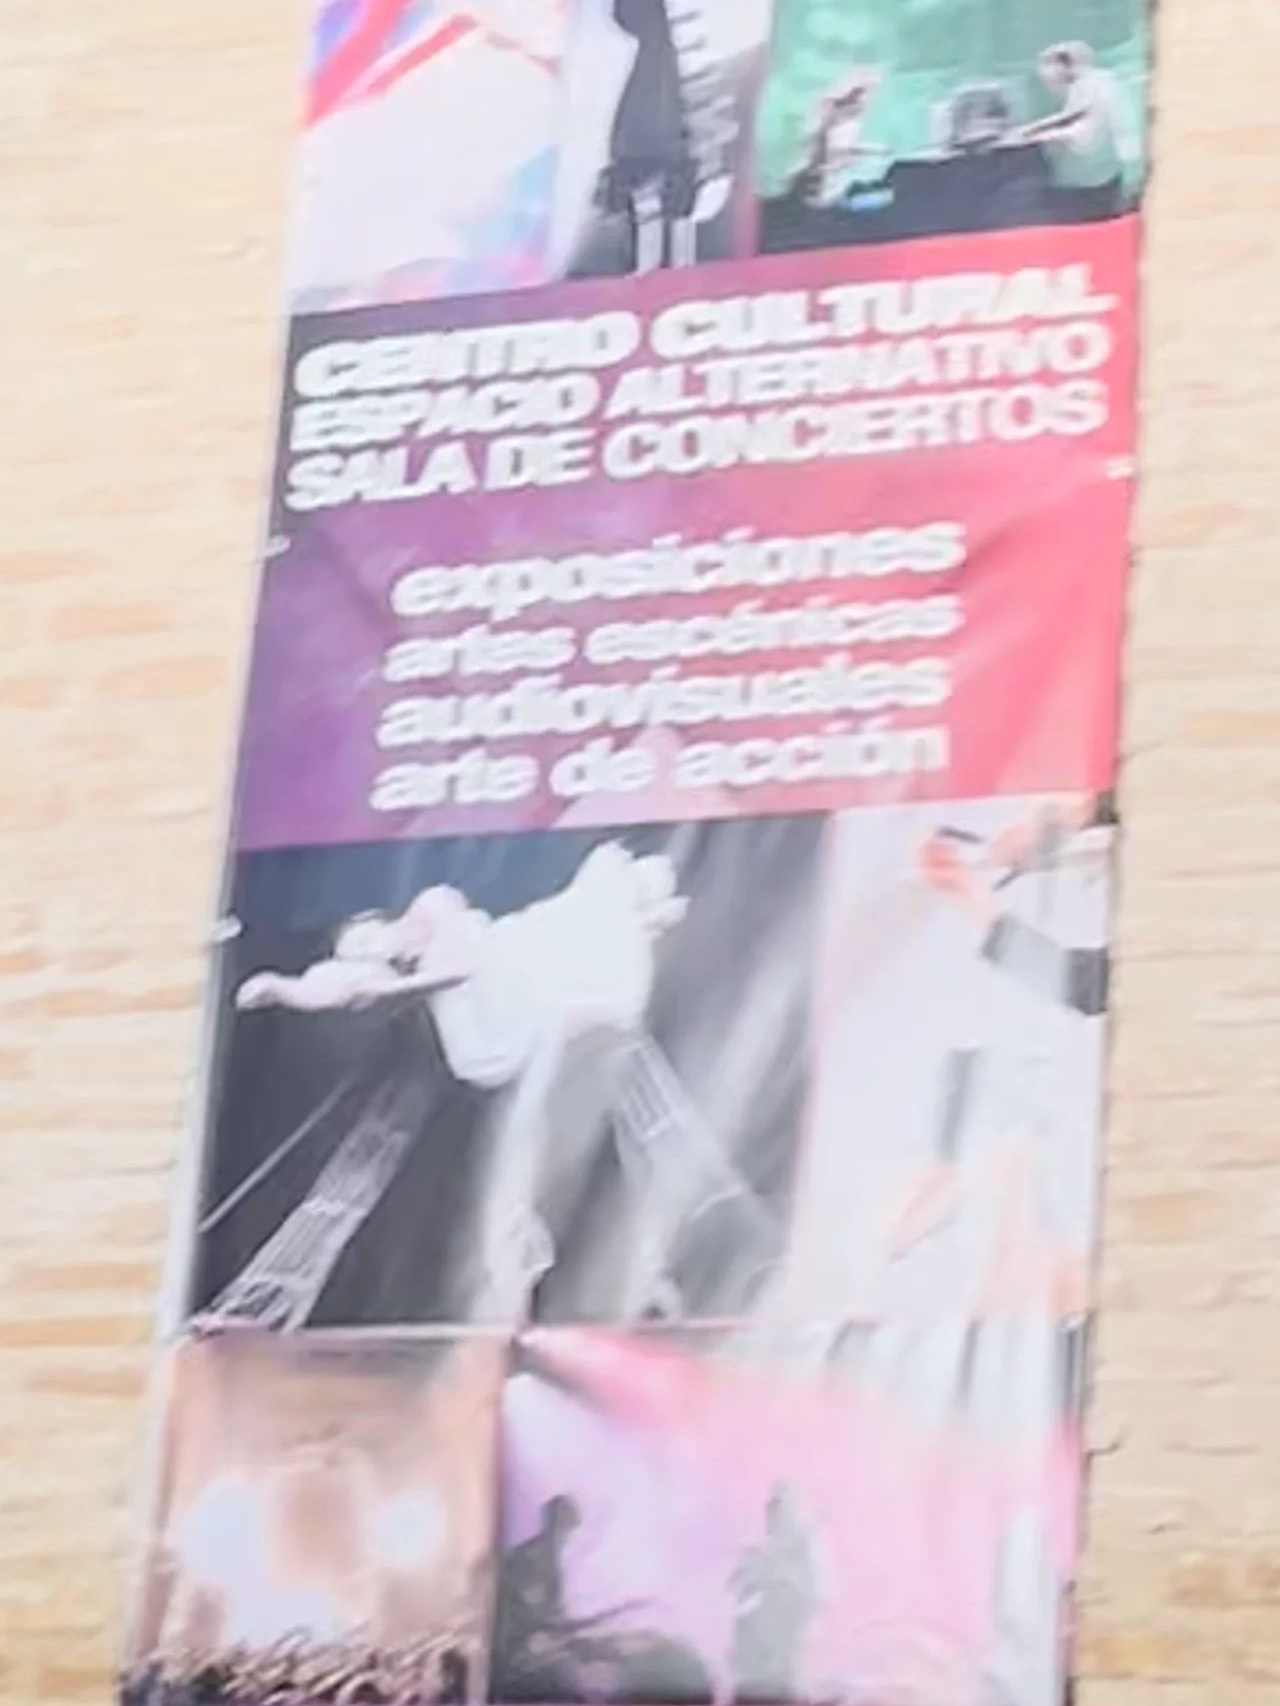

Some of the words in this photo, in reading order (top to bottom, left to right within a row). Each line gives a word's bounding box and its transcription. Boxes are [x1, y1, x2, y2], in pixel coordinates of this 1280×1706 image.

[294, 310, 641, 397] CENTRO
[649, 263, 1116, 358] CULTURAL
[289, 372, 602, 452] ESPACIO
[602, 322, 1109, 420] ALTERNATIVO
[285, 440, 478, 511] SALA
[482, 427, 597, 491] DE
[602, 378, 1108, 479] CONCIERTOS
[390, 523, 966, 622] exposiciones
[382, 624, 578, 682] artes
[584, 596, 965, 664] escénicas
[375, 653, 953, 747] audiovisuales
[369, 747, 539, 810] arte
[549, 737, 657, 796] de
[674, 716, 950, 786] acción
